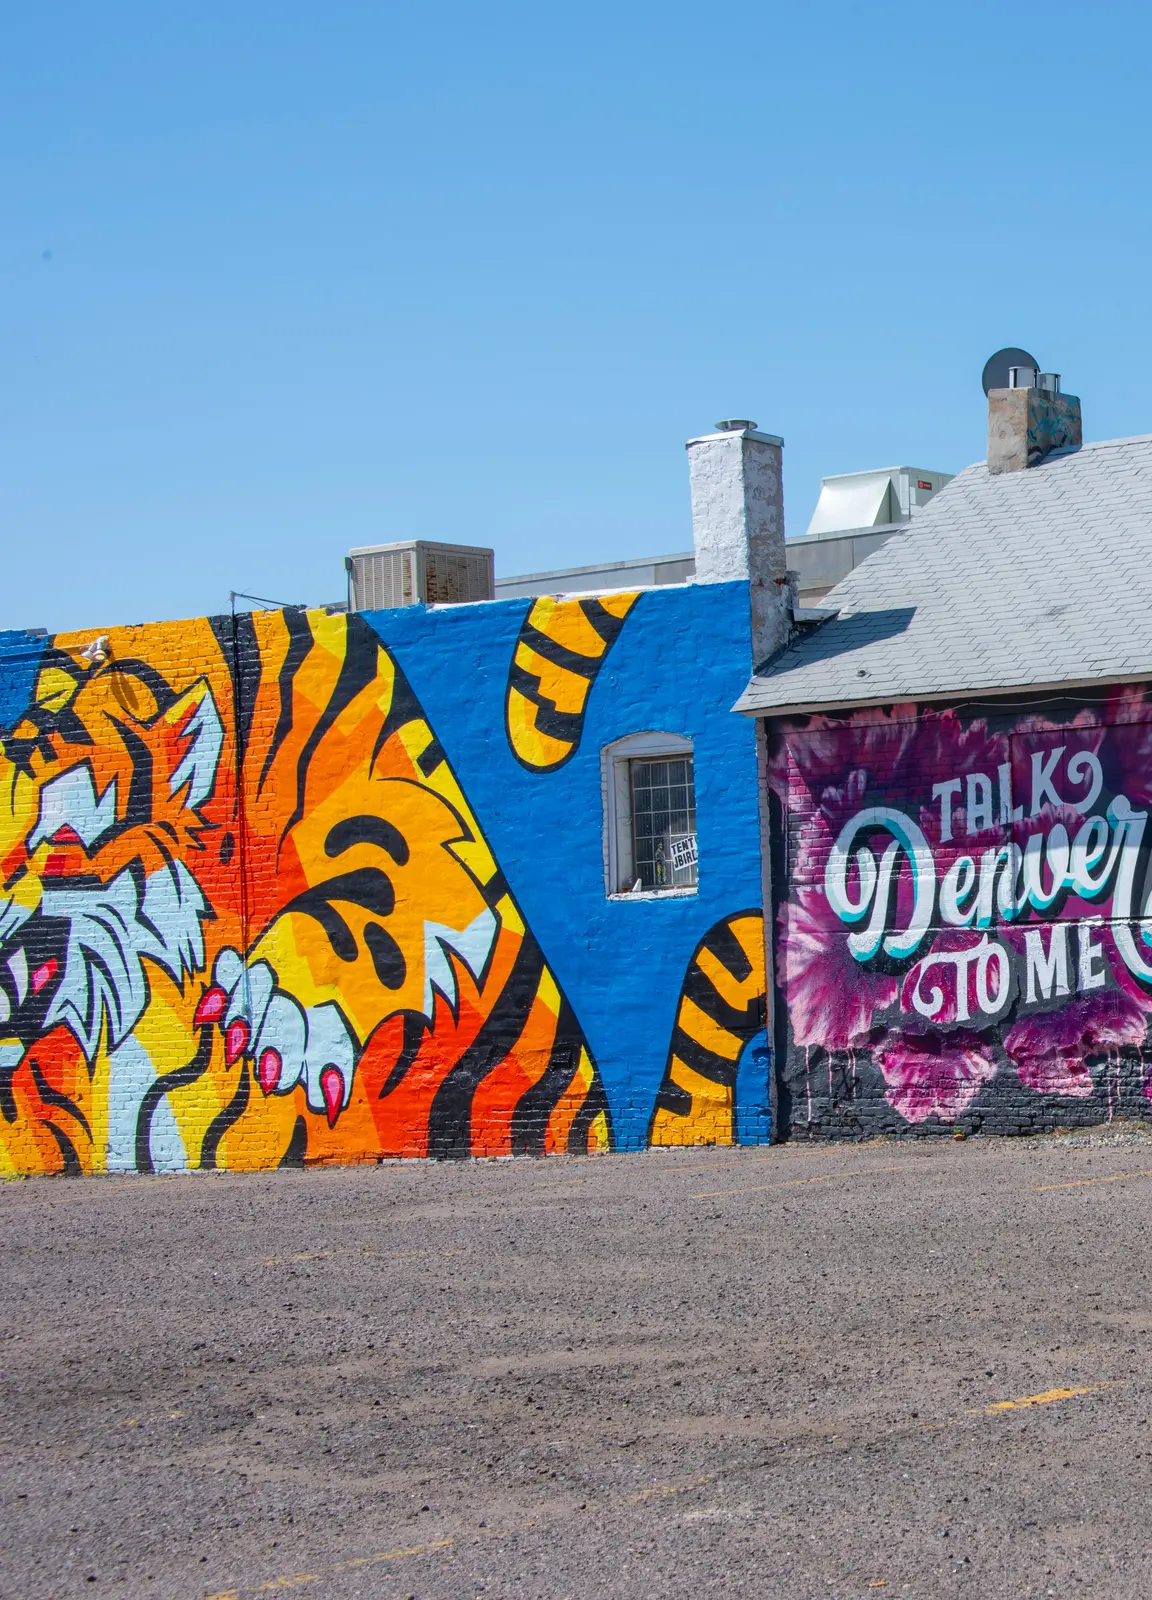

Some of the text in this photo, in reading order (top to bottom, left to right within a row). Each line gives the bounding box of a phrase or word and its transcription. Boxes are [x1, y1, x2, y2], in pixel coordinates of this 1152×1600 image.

[932, 745, 1104, 844] TALK
[671, 838, 693, 855] TENT
[911, 915, 1107, 1023] TO ME
